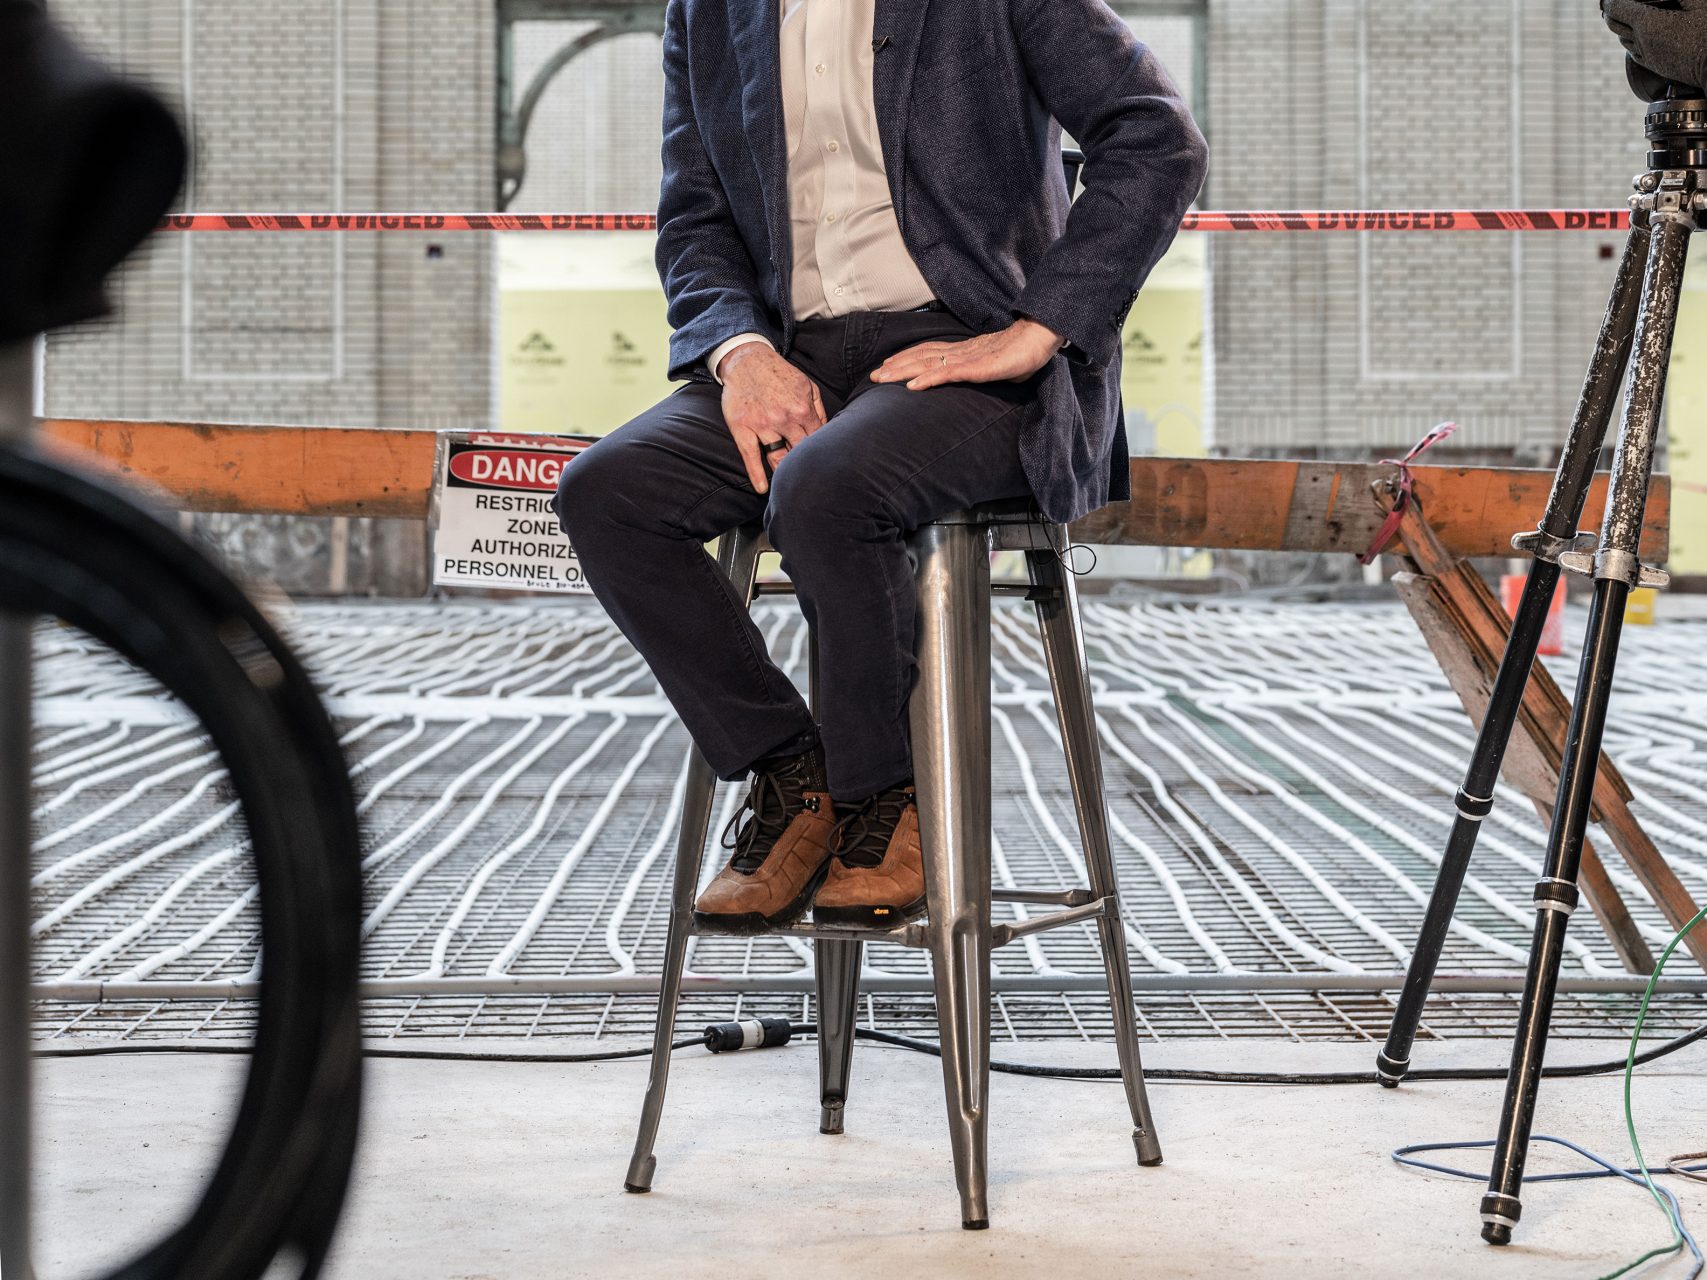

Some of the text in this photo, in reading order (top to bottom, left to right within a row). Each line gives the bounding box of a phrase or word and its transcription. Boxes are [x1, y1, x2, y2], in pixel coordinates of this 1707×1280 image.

[471, 454, 567, 484] DANG
[507, 519, 559, 536] ZONE
[444, 559, 559, 580] PERSONNEL
